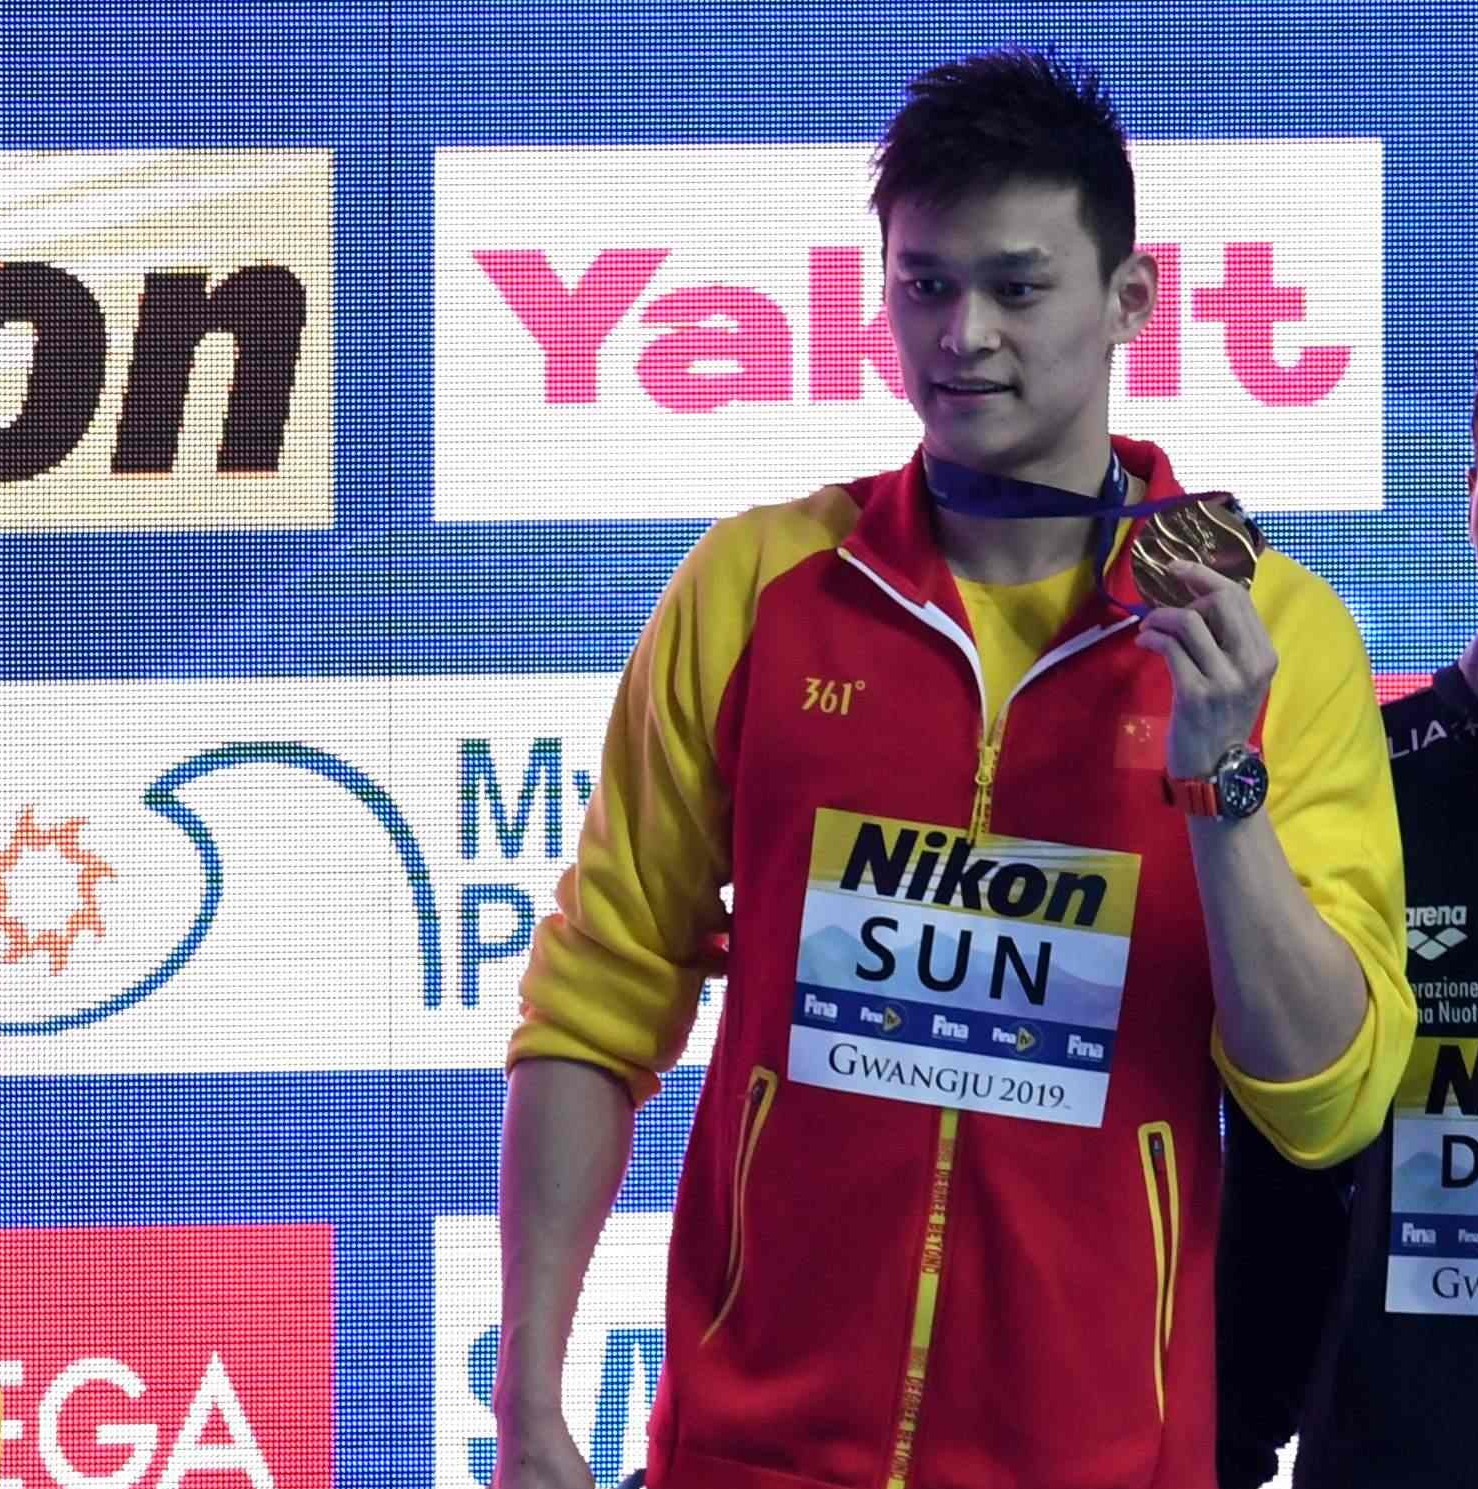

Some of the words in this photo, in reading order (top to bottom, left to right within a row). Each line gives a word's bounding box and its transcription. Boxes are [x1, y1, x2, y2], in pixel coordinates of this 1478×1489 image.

[470, 240, 1353, 413] Yaklt
[839, 821, 1108, 928] Nikon
[854, 916, 1054, 1007] SUN
[998, 1077, 1066, 1110] 2019
